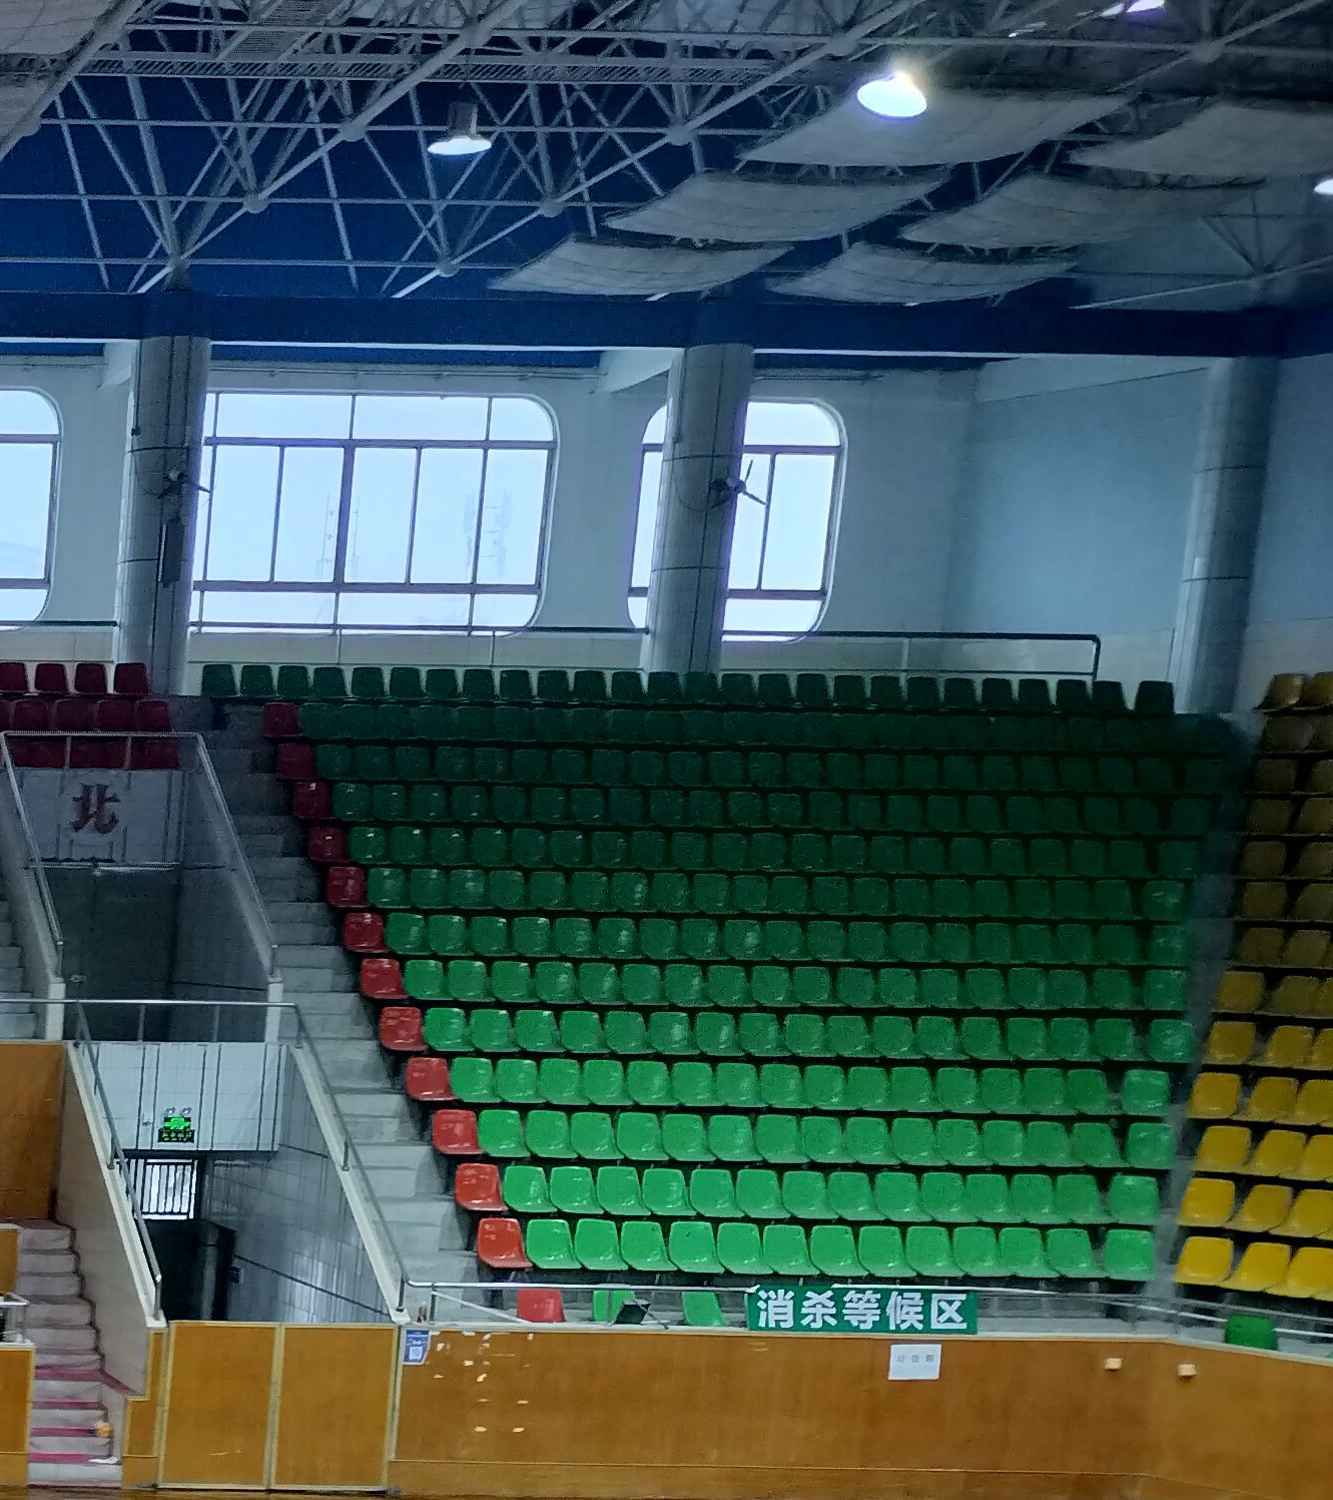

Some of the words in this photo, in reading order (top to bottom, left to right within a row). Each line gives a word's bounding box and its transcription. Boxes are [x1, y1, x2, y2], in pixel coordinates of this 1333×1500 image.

[70, 783, 121, 834] 北
[757, 1289, 967, 1330] 消杀等候区
